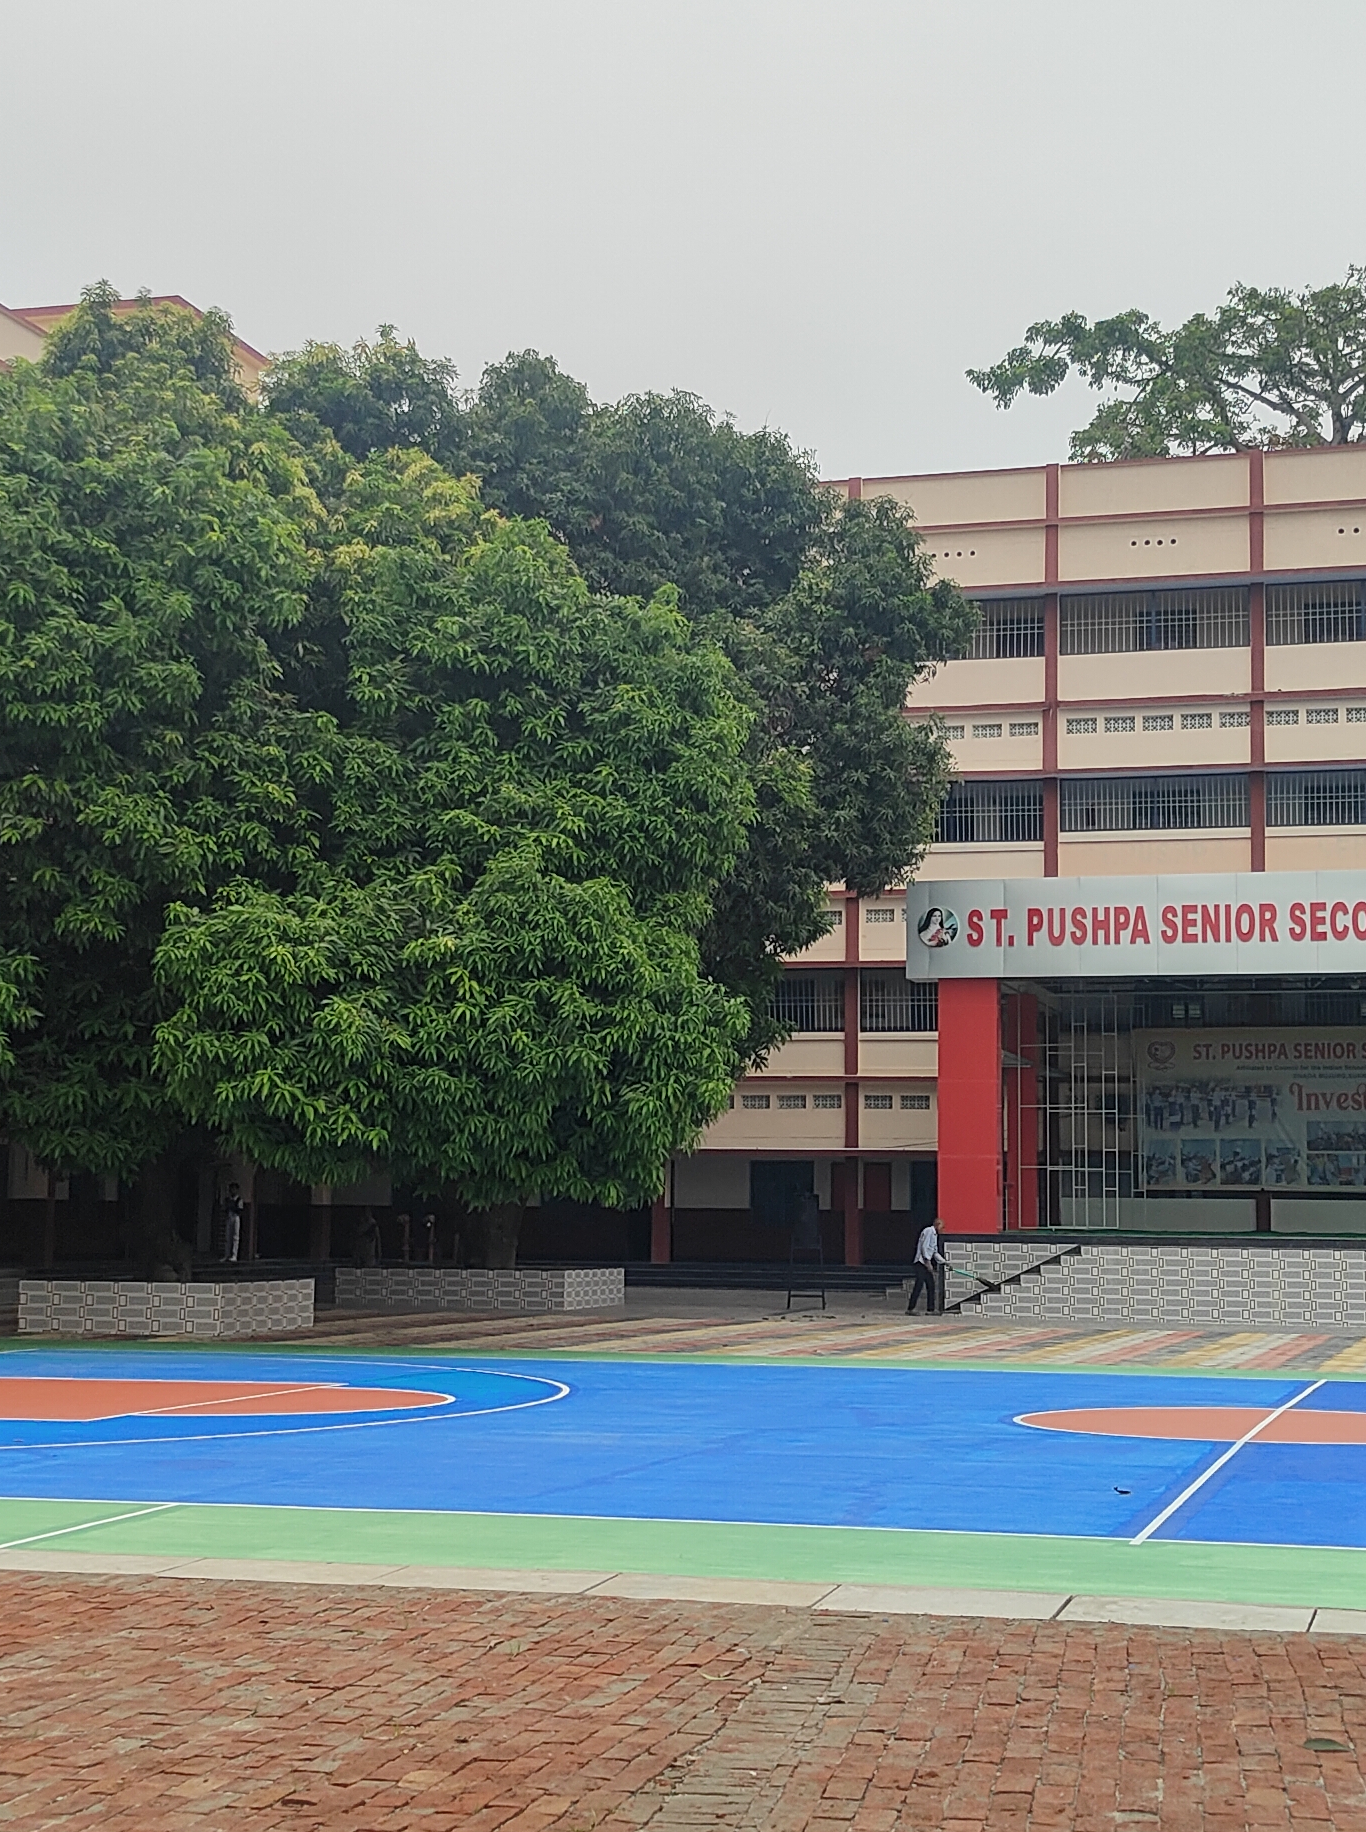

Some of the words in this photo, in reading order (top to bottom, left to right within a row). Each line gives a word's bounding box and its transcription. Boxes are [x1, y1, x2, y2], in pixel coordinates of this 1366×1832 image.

[966, 908, 1016, 948] ST.
[1027, 905, 1152, 948] PUSHPA
[1161, 902, 1280, 945] SENIOR
[1192, 1042, 1217, 1061] ST.
[1220, 1042, 1289, 1060] PUSHPA
[1293, 1042, 1357, 1060] SENIOR
